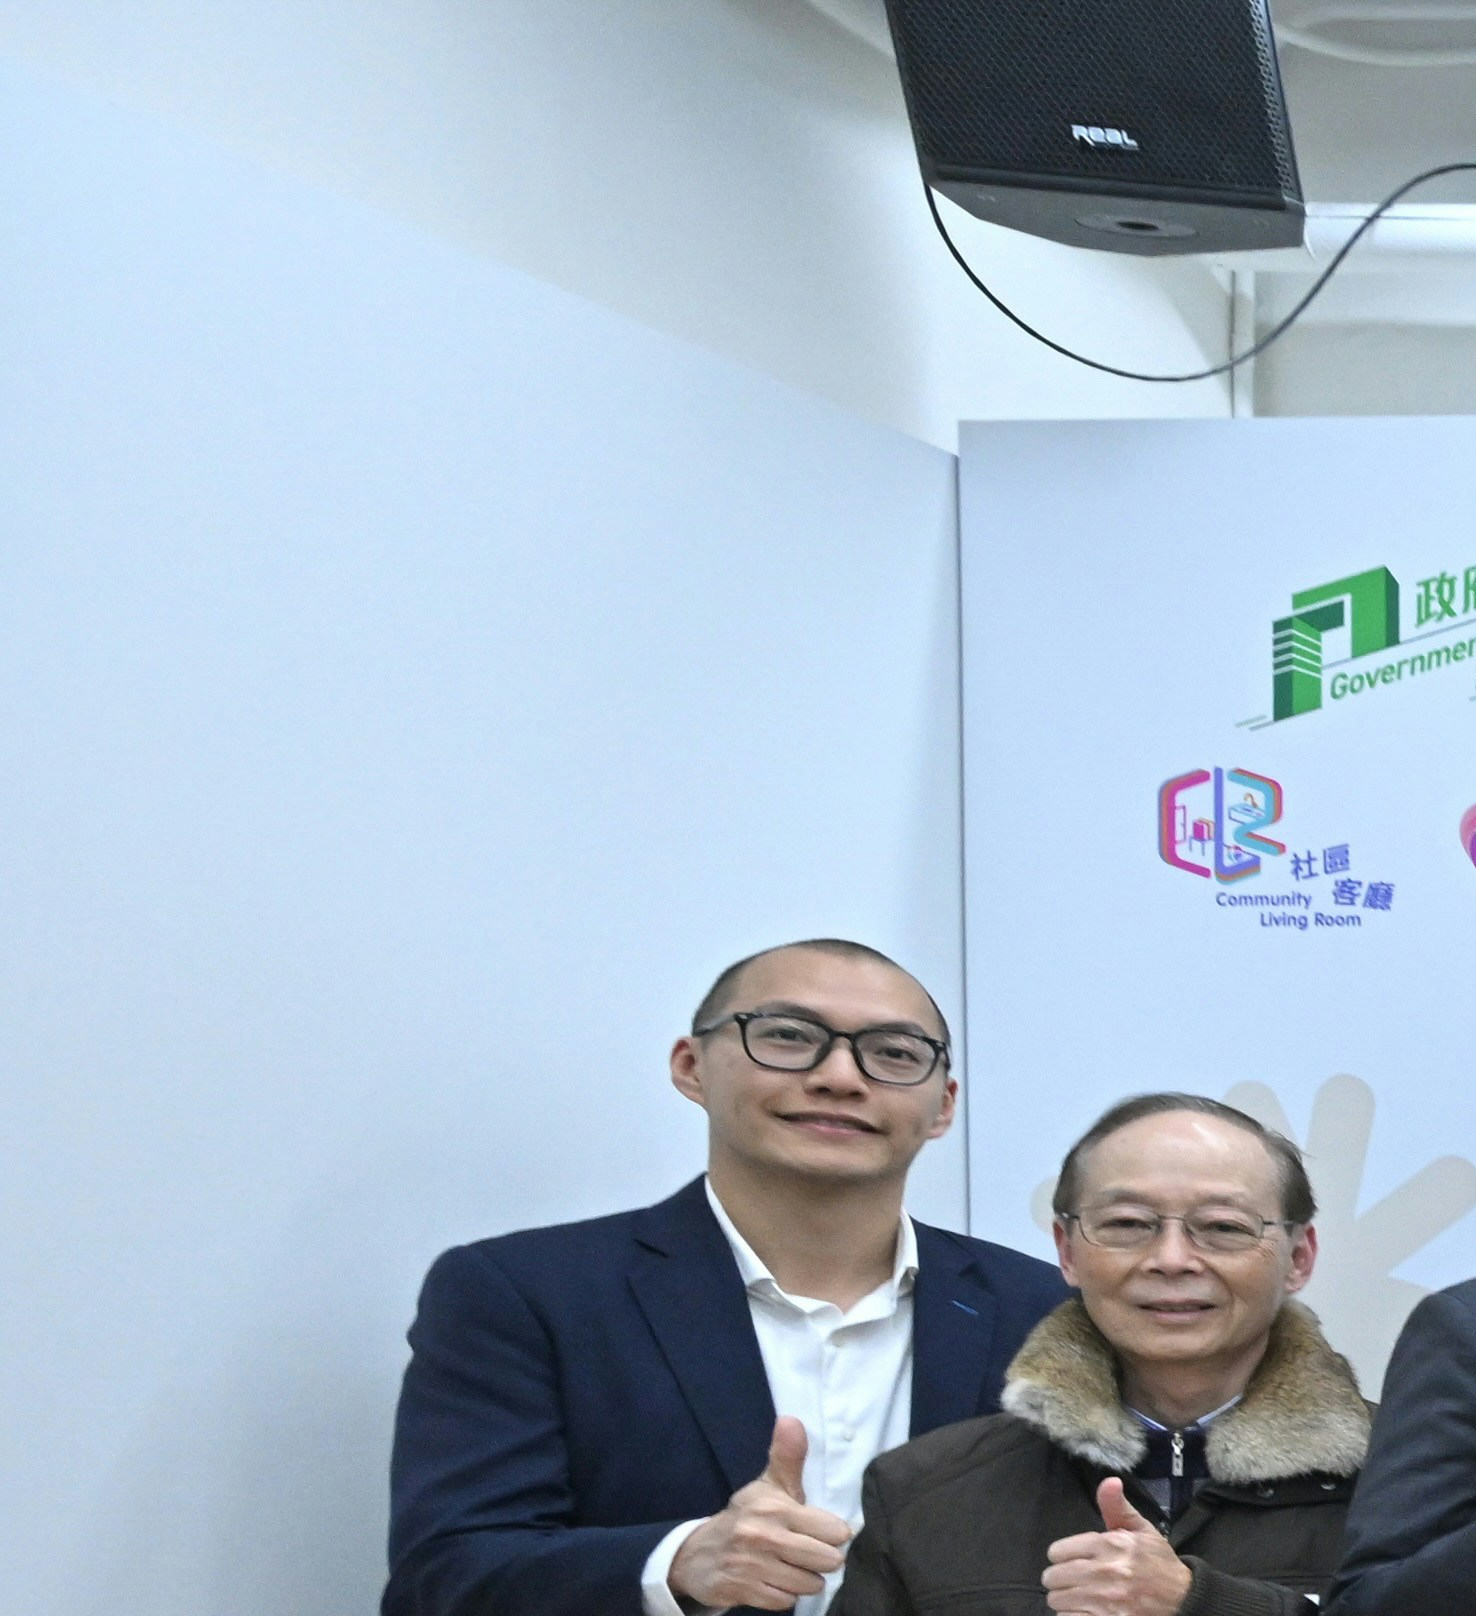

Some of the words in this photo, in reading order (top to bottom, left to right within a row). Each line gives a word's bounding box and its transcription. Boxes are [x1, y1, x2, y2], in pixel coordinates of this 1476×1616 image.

[1216, 892, 1311, 909] Community
[1261, 912, 1307, 930] Living
[1315, 913, 1361, 926] Room
